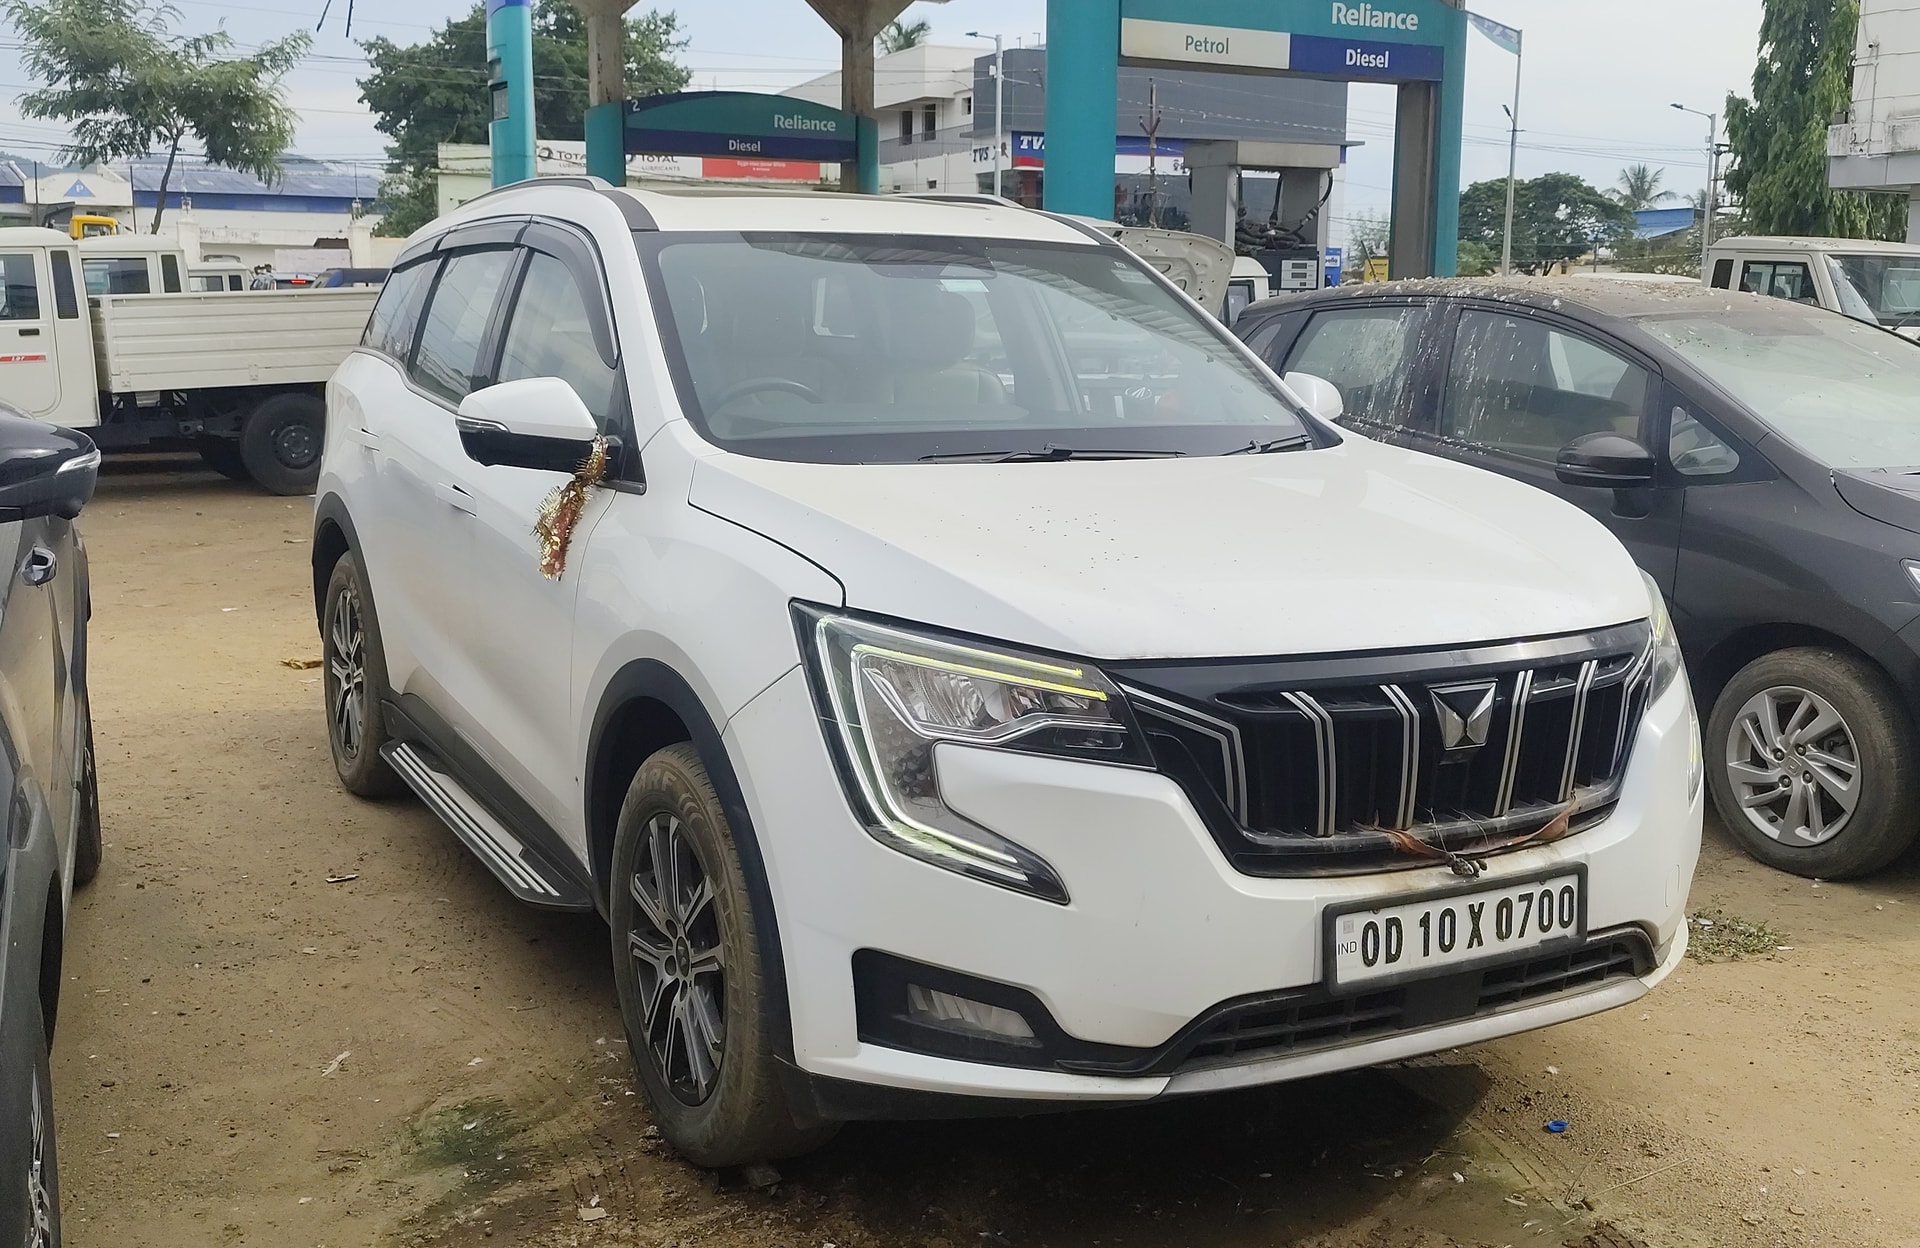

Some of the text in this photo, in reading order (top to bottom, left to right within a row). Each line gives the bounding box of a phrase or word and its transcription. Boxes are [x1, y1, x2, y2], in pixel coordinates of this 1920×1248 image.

[1331, 2, 1419, 31] Reliance
[1185, 35, 1230, 55] Petrol
[1345, 48, 1389, 69] Diesel
[632, 100, 641, 112] 2
[774, 114, 837, 132] Reliance
[728, 140, 761, 152] Diesel
[1020, 135, 1045, 150] TV
[641, 154, 679, 163] TOTAL
[973, 146, 989, 162] TVS
[1361, 885, 1575, 967] OD 10 X 0700
[1337, 941, 1358, 956] IND
